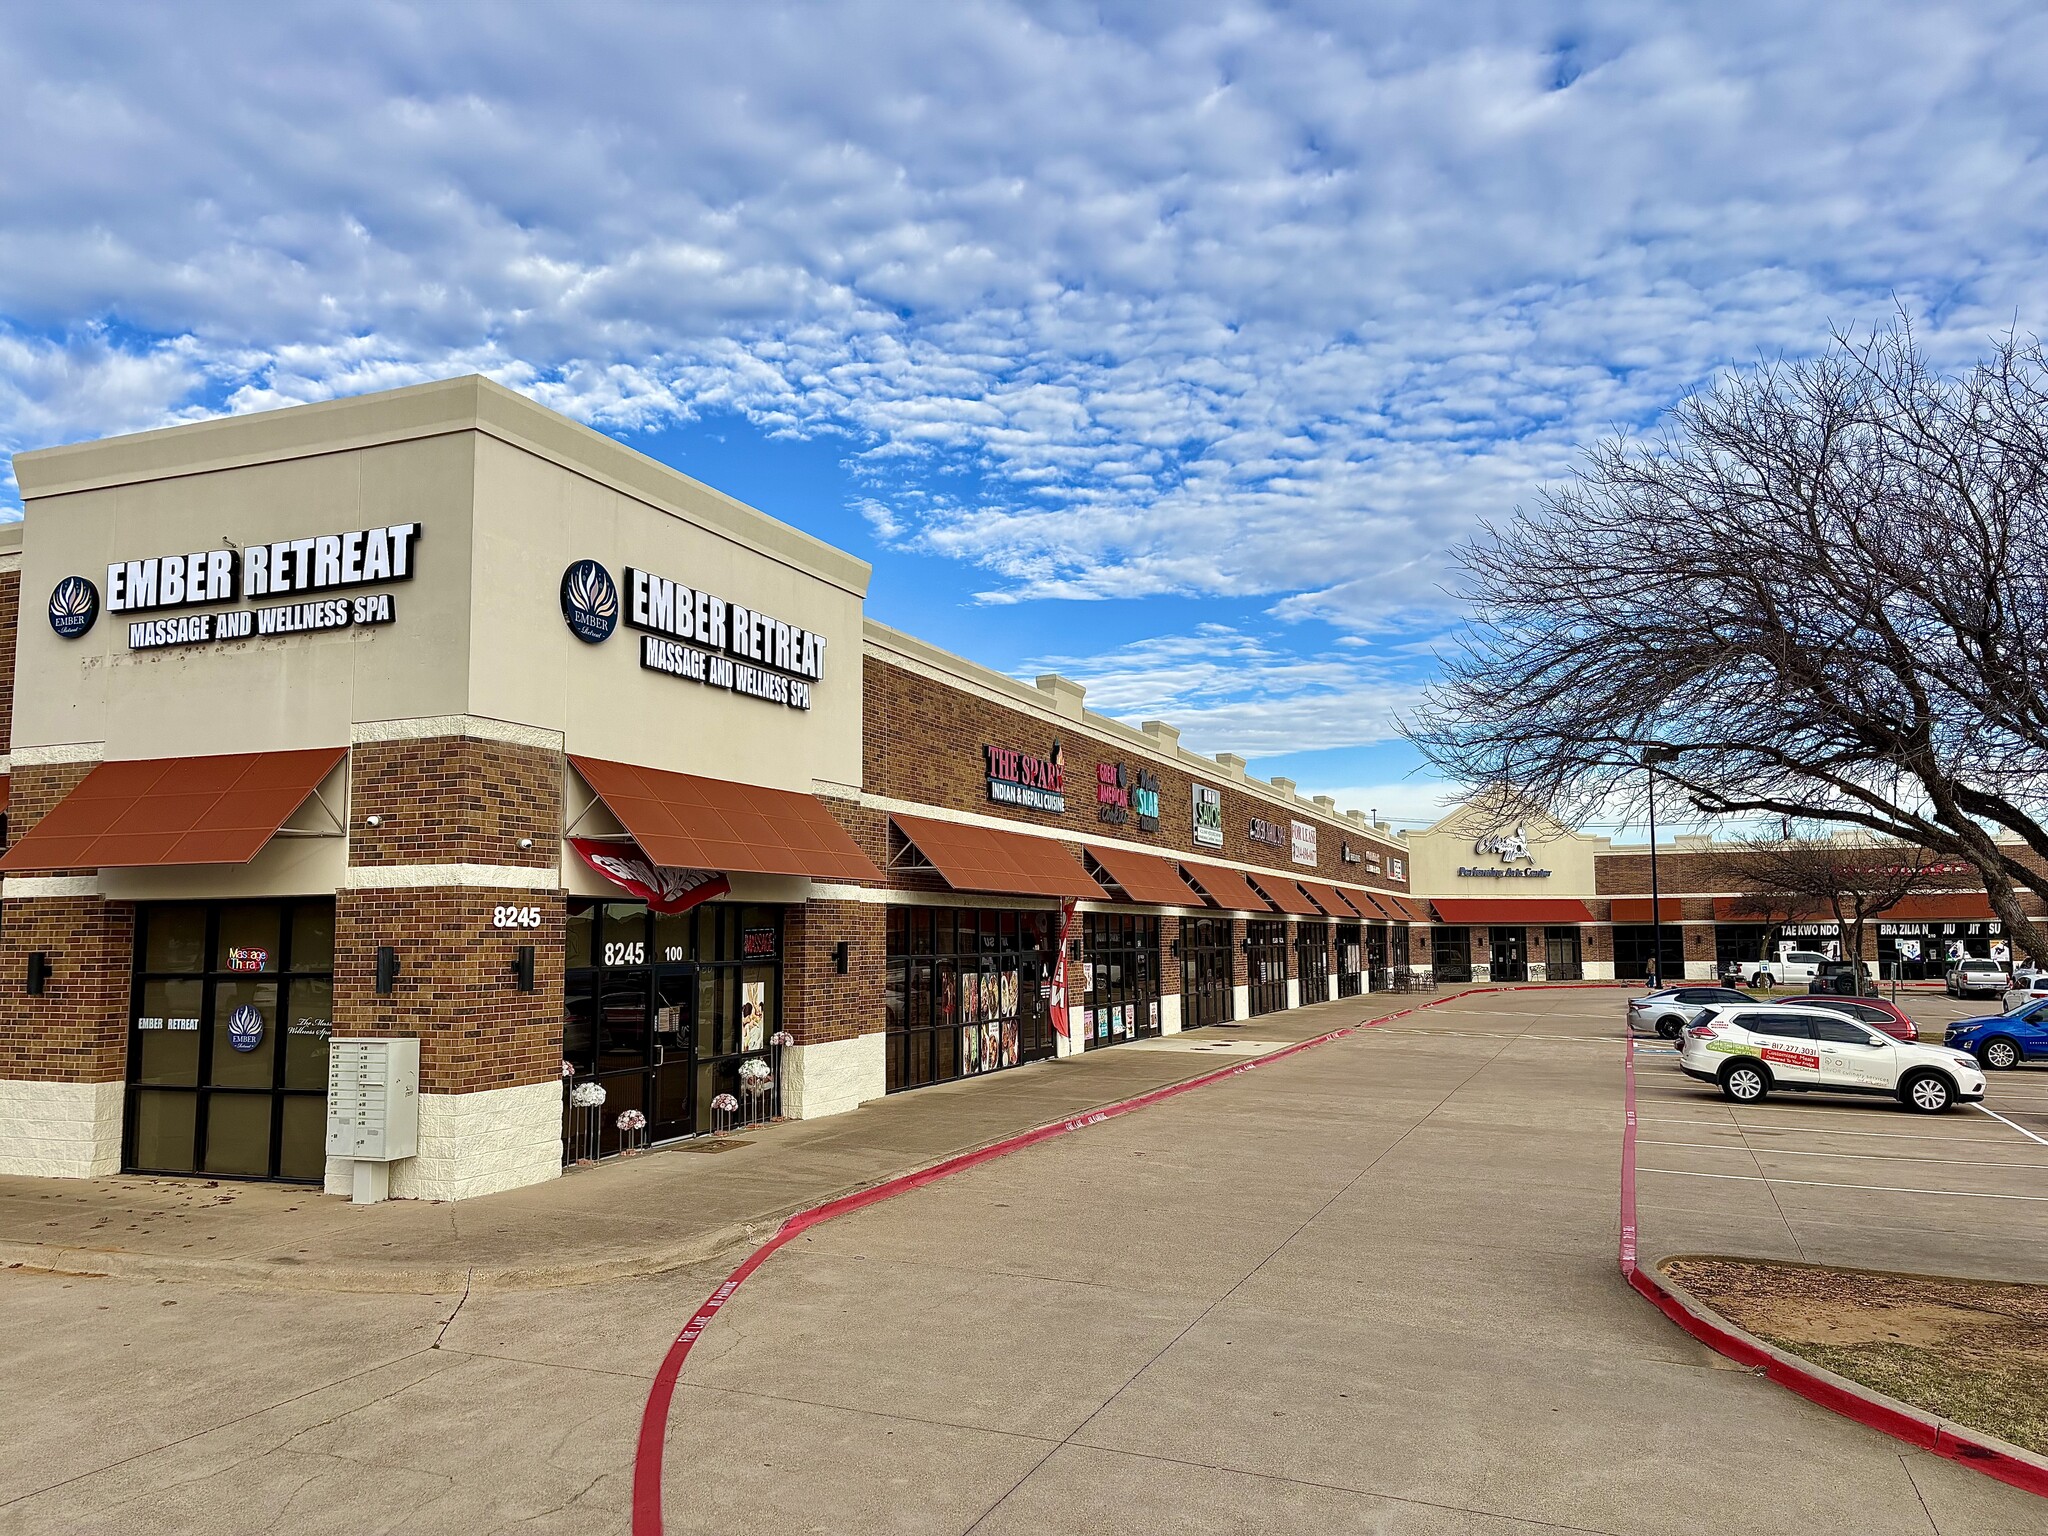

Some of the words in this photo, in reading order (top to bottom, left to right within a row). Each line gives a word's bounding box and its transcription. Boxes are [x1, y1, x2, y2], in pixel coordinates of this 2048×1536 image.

[106, 550, 235, 613] EMBER
[243, 523, 414, 597] RETREAT
[55, 616, 85, 627] EMBER
[130, 617, 211, 648] MASSAGE
[215, 612, 252, 638] AND
[256, 600, 349, 634] WELLNESS
[352, 596, 390, 623] SPA
[575, 611, 608, 631] EMBER
[632, 567, 726, 648] EMBER
[732, 604, 827, 680] RETREAT
[646, 637, 706, 680] MASSAGE
[709, 657, 733, 688] AND
[735, 664, 788, 704] WELLNESS
[790, 681, 810, 708] SPA
[988, 745, 1019, 782] THE
[1022, 754, 1065, 792] SPARK
[1099, 764, 1118, 784] GREAT
[992, 782, 1016, 802] INDIAN
[1017, 787, 1022, 802] &
[1022, 789, 1043, 808] NEPALI
[1044, 794, 1065, 812] CUISINE
[1100, 784, 1128, 808] AMERICAN
[1138, 788, 1159, 818] SLAB
[1458, 867, 1504, 879] Performing
[1504, 867, 1524, 877] Arts
[1524, 867, 1552, 877] Center
[493, 906, 541, 927] 8245
[1943, 923, 1956, 935] JIU
[1968, 923, 1980, 935] JIT
[1988, 923, 2001, 934] SU
[229, 947, 267, 961] Massage
[604, 942, 645, 966] 8245
[665, 946, 683, 961] 100
[231, 958, 265, 971] Therapy
[138, 1017, 163, 1029] EMBER
[168, 1018, 199, 1030] RETREAT
[288, 1026, 315, 1034] Wellness
[297, 1016, 313, 1027] The
[233, 1035, 257, 1043] EMBER
[1771, 1042, 1817, 1056] 817.277.3031
